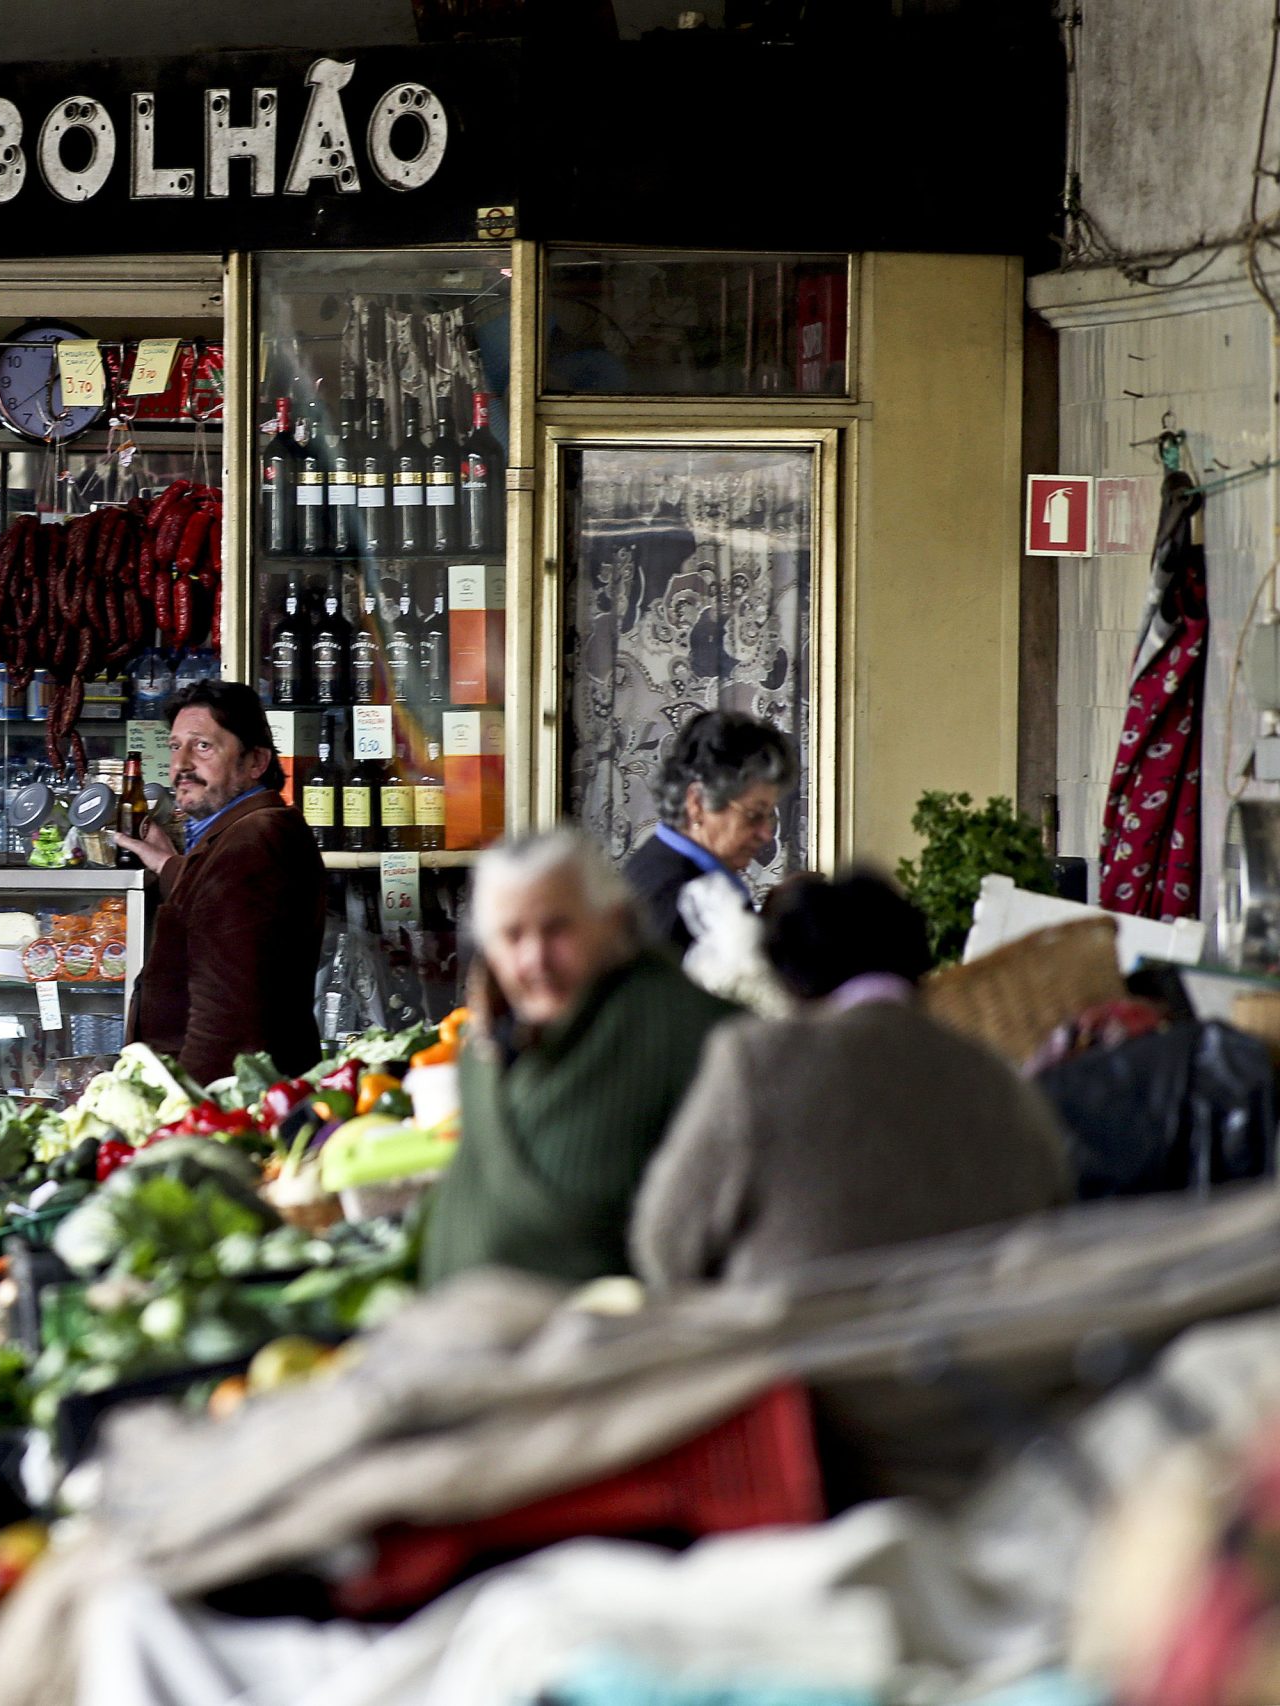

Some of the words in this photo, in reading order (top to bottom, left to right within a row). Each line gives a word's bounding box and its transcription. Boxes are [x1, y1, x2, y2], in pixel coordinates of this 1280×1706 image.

[7, 355, 22, 368] 10
[1, 376, 11, 388] 9
[65, 376, 93, 394] 3.70
[8, 397, 17, 410] 8
[23, 413, 32, 425] 7
